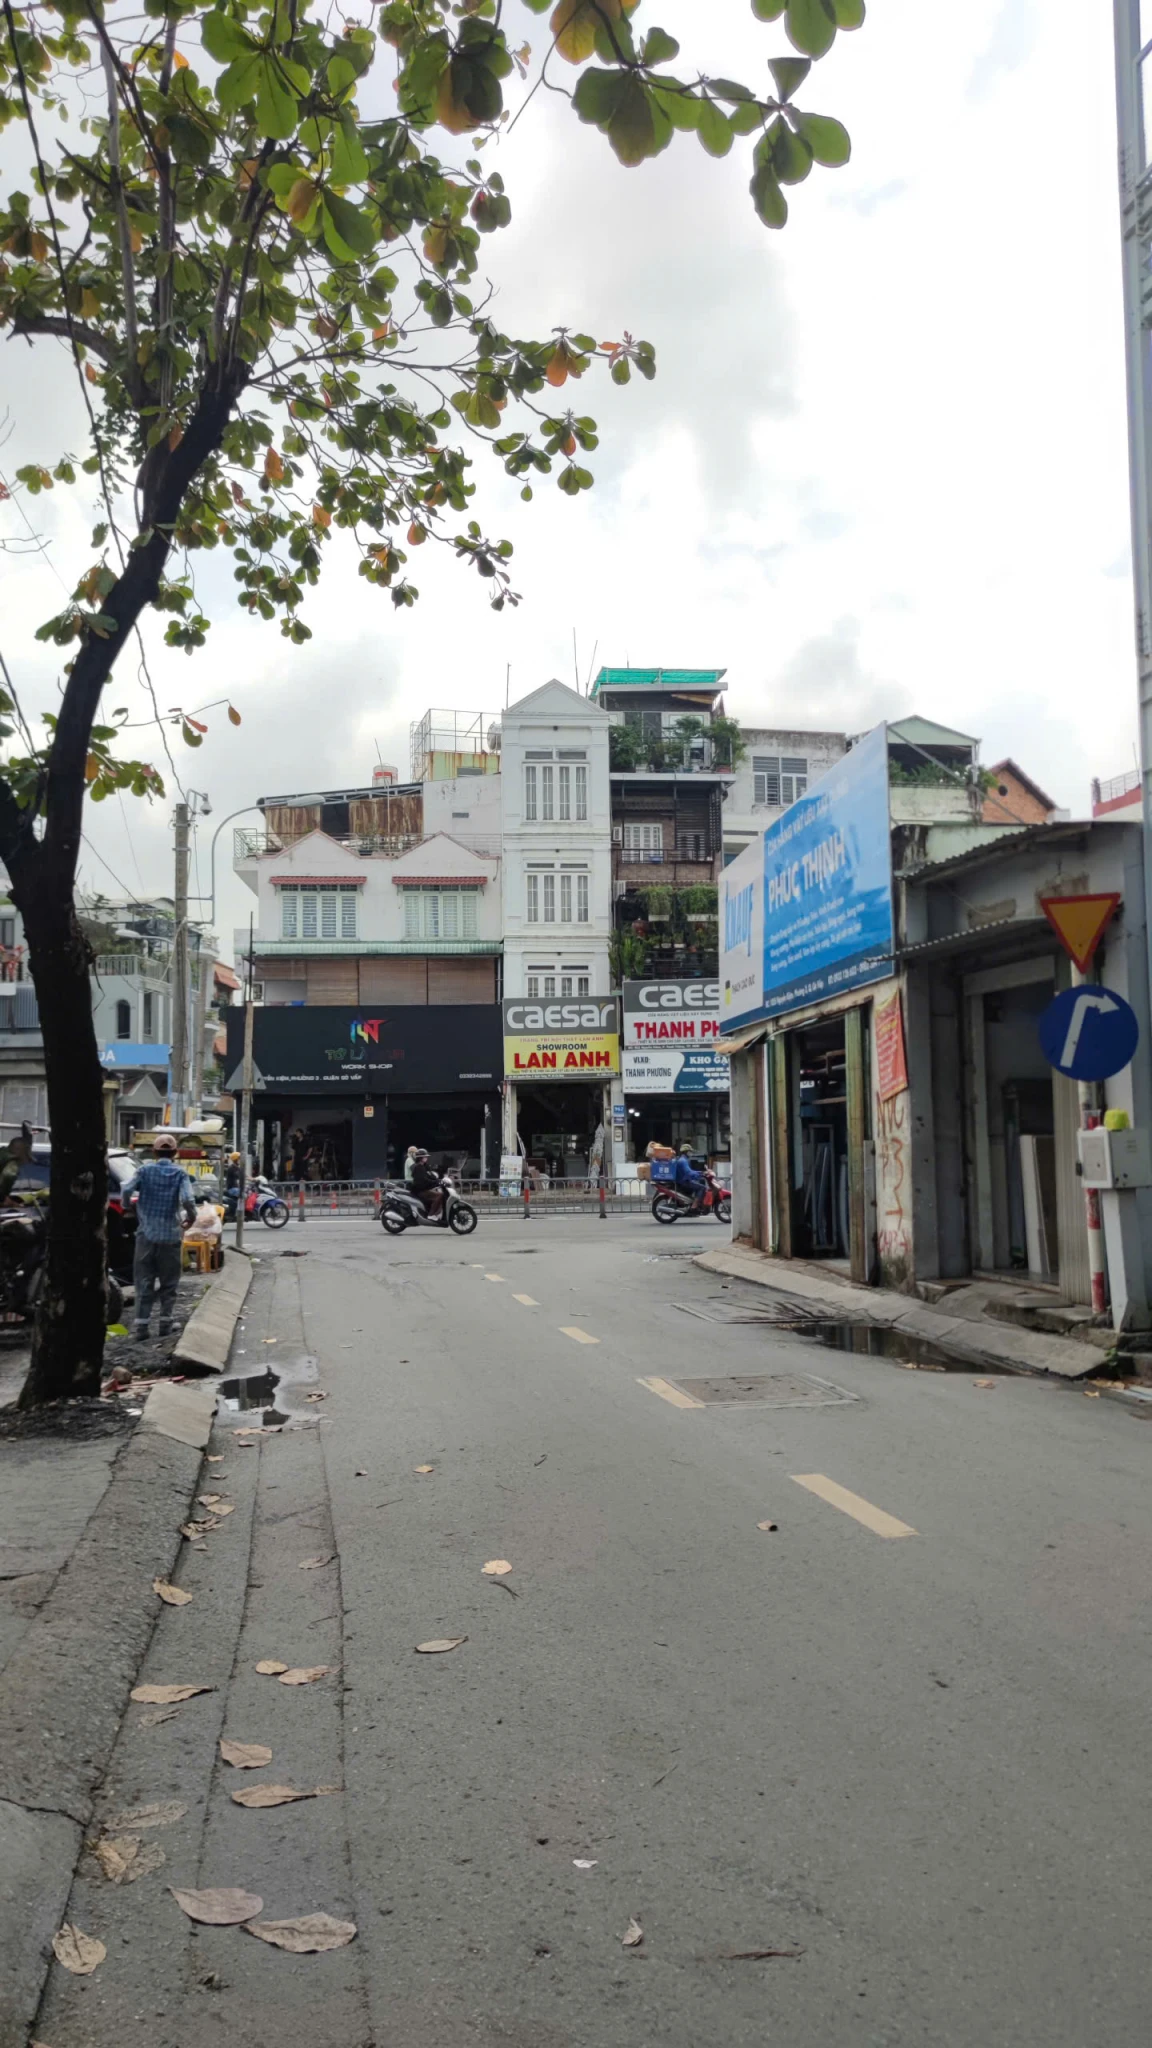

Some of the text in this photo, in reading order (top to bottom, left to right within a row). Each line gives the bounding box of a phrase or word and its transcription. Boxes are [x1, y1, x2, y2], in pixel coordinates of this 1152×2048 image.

[768, 828, 846, 912] PHÚC THỊNH
[506, 1004, 615, 1029] caesar
[633, 1021, 695, 1039] THANH
[536, 1043, 588, 1051] SHOWROOM
[514, 1051, 610, 1069] LAN ANH
[690, 1056, 711, 1064] KHO
[625, 1068, 645, 1078] THANH
[646, 1067, 672, 1077] PHƯƠNG
